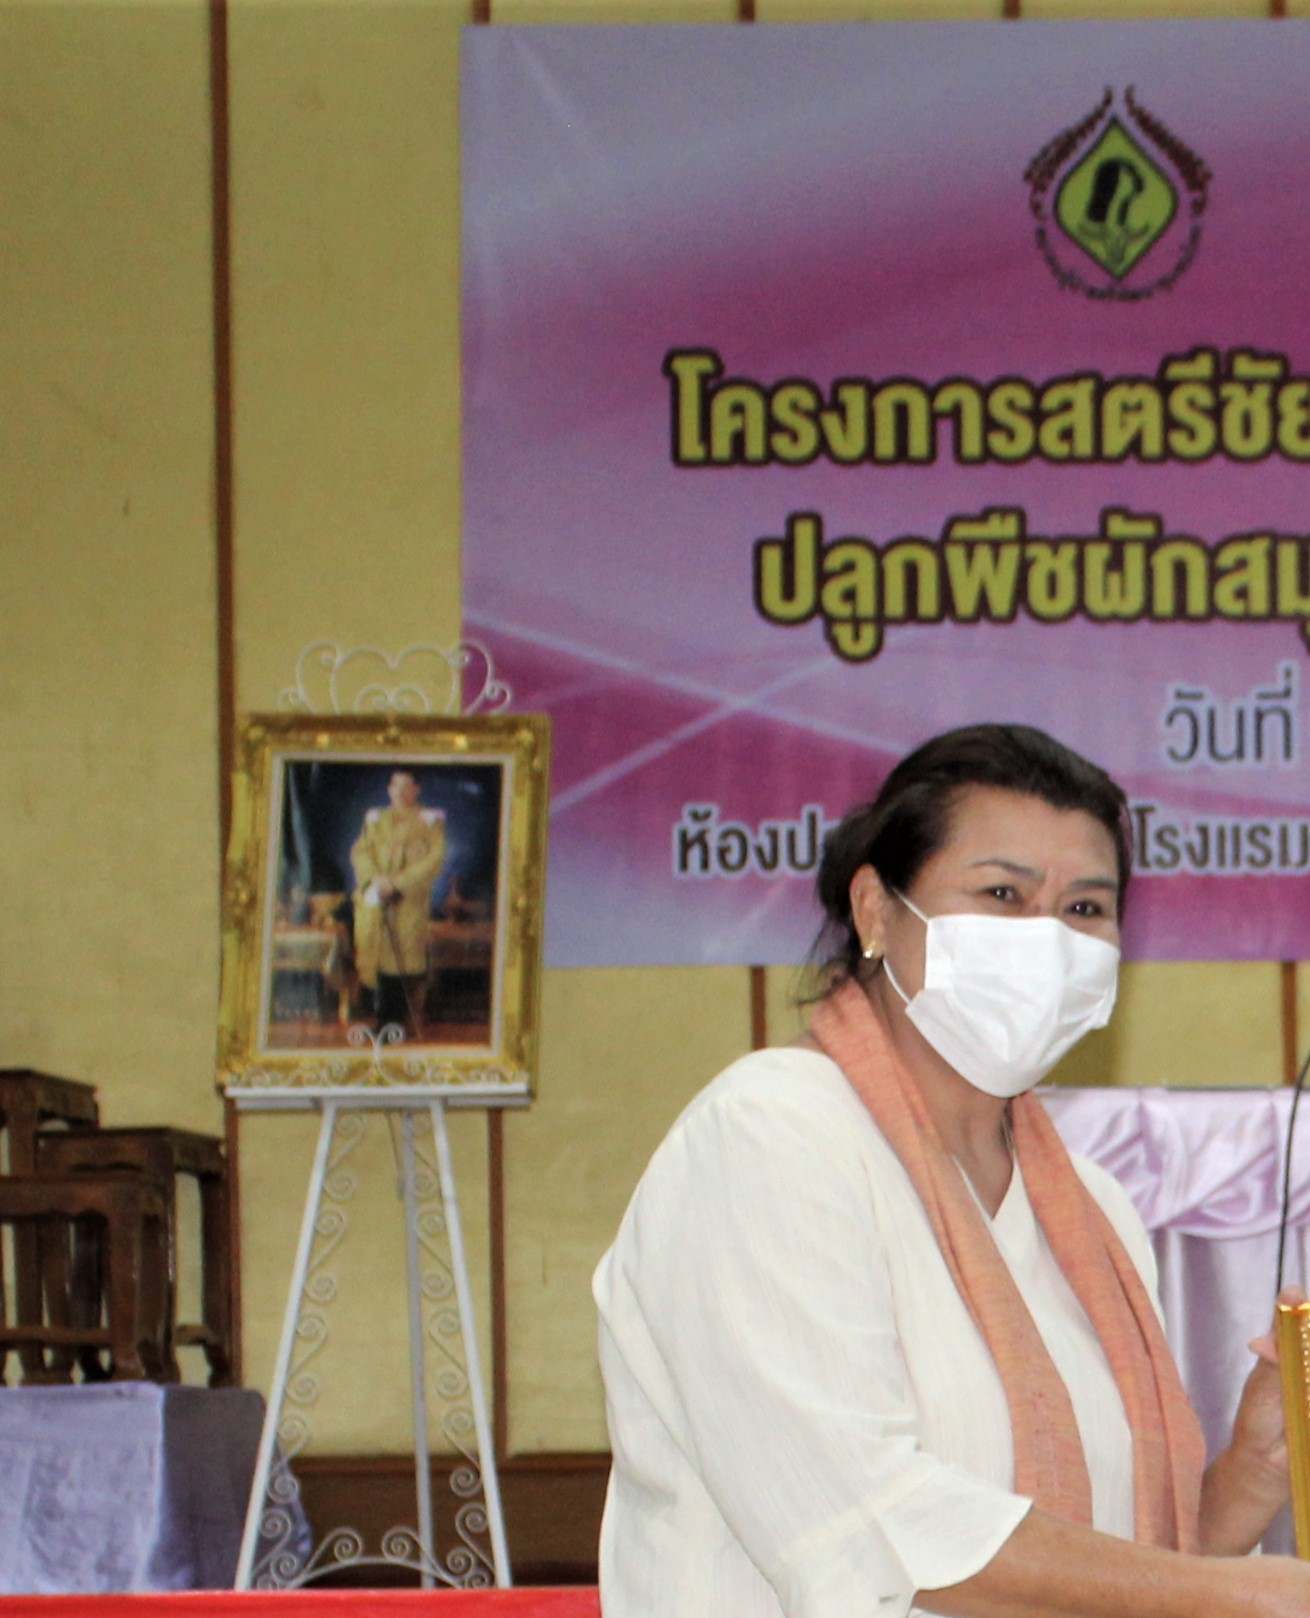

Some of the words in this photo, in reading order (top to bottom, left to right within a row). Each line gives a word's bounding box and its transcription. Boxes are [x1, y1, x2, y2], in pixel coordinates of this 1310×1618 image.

[1164, 664, 1294, 763] วันที่
[677, 808, 822, 873] ห้องป
